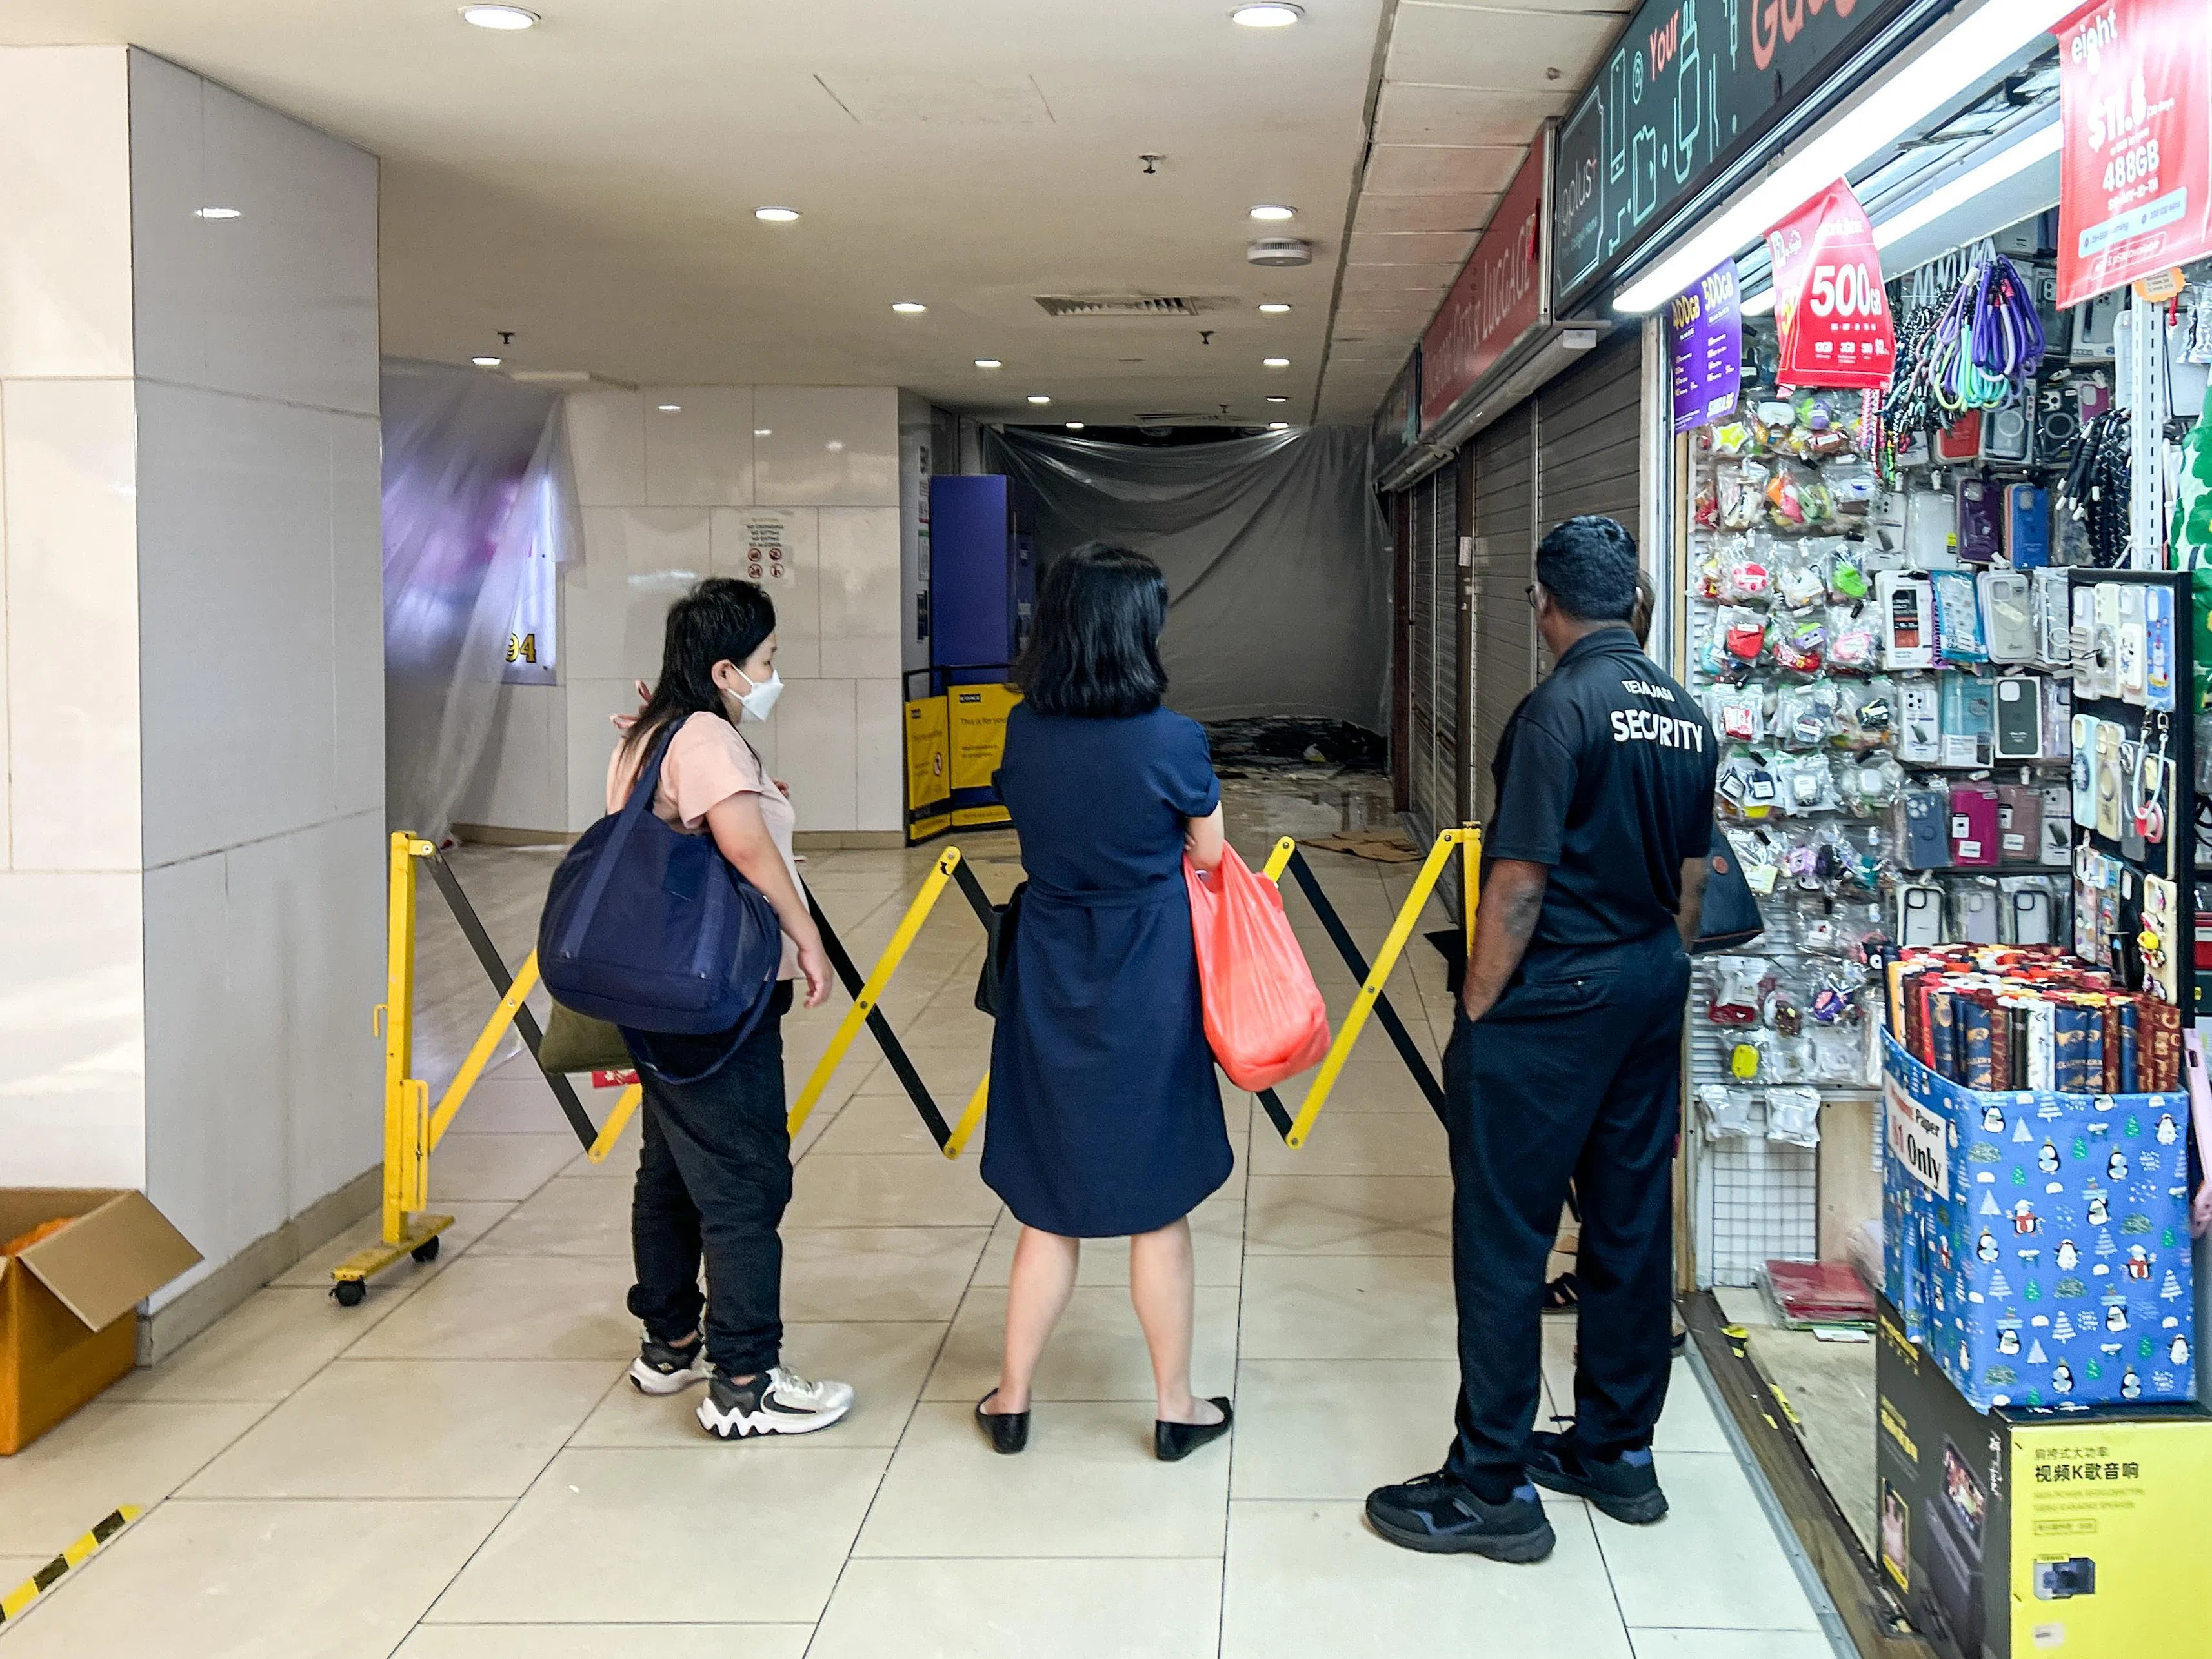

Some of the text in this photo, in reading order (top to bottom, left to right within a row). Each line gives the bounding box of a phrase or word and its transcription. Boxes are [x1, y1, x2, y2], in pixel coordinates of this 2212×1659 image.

[1649, 10, 1679, 82] Your
[2071, 8, 2118, 75] eight
[2102, 139, 2159, 191] 488GB
[1482, 214, 1535, 341] LUGGAGE
[1701, 272, 1733, 312] 500GB
[1611, 709, 1703, 752] SECURITY
[1916, 1107, 1940, 1139] Paper
[1907, 1132, 1942, 1189] Only
[2035, 1462, 2139, 1482] 视频K歌音响
